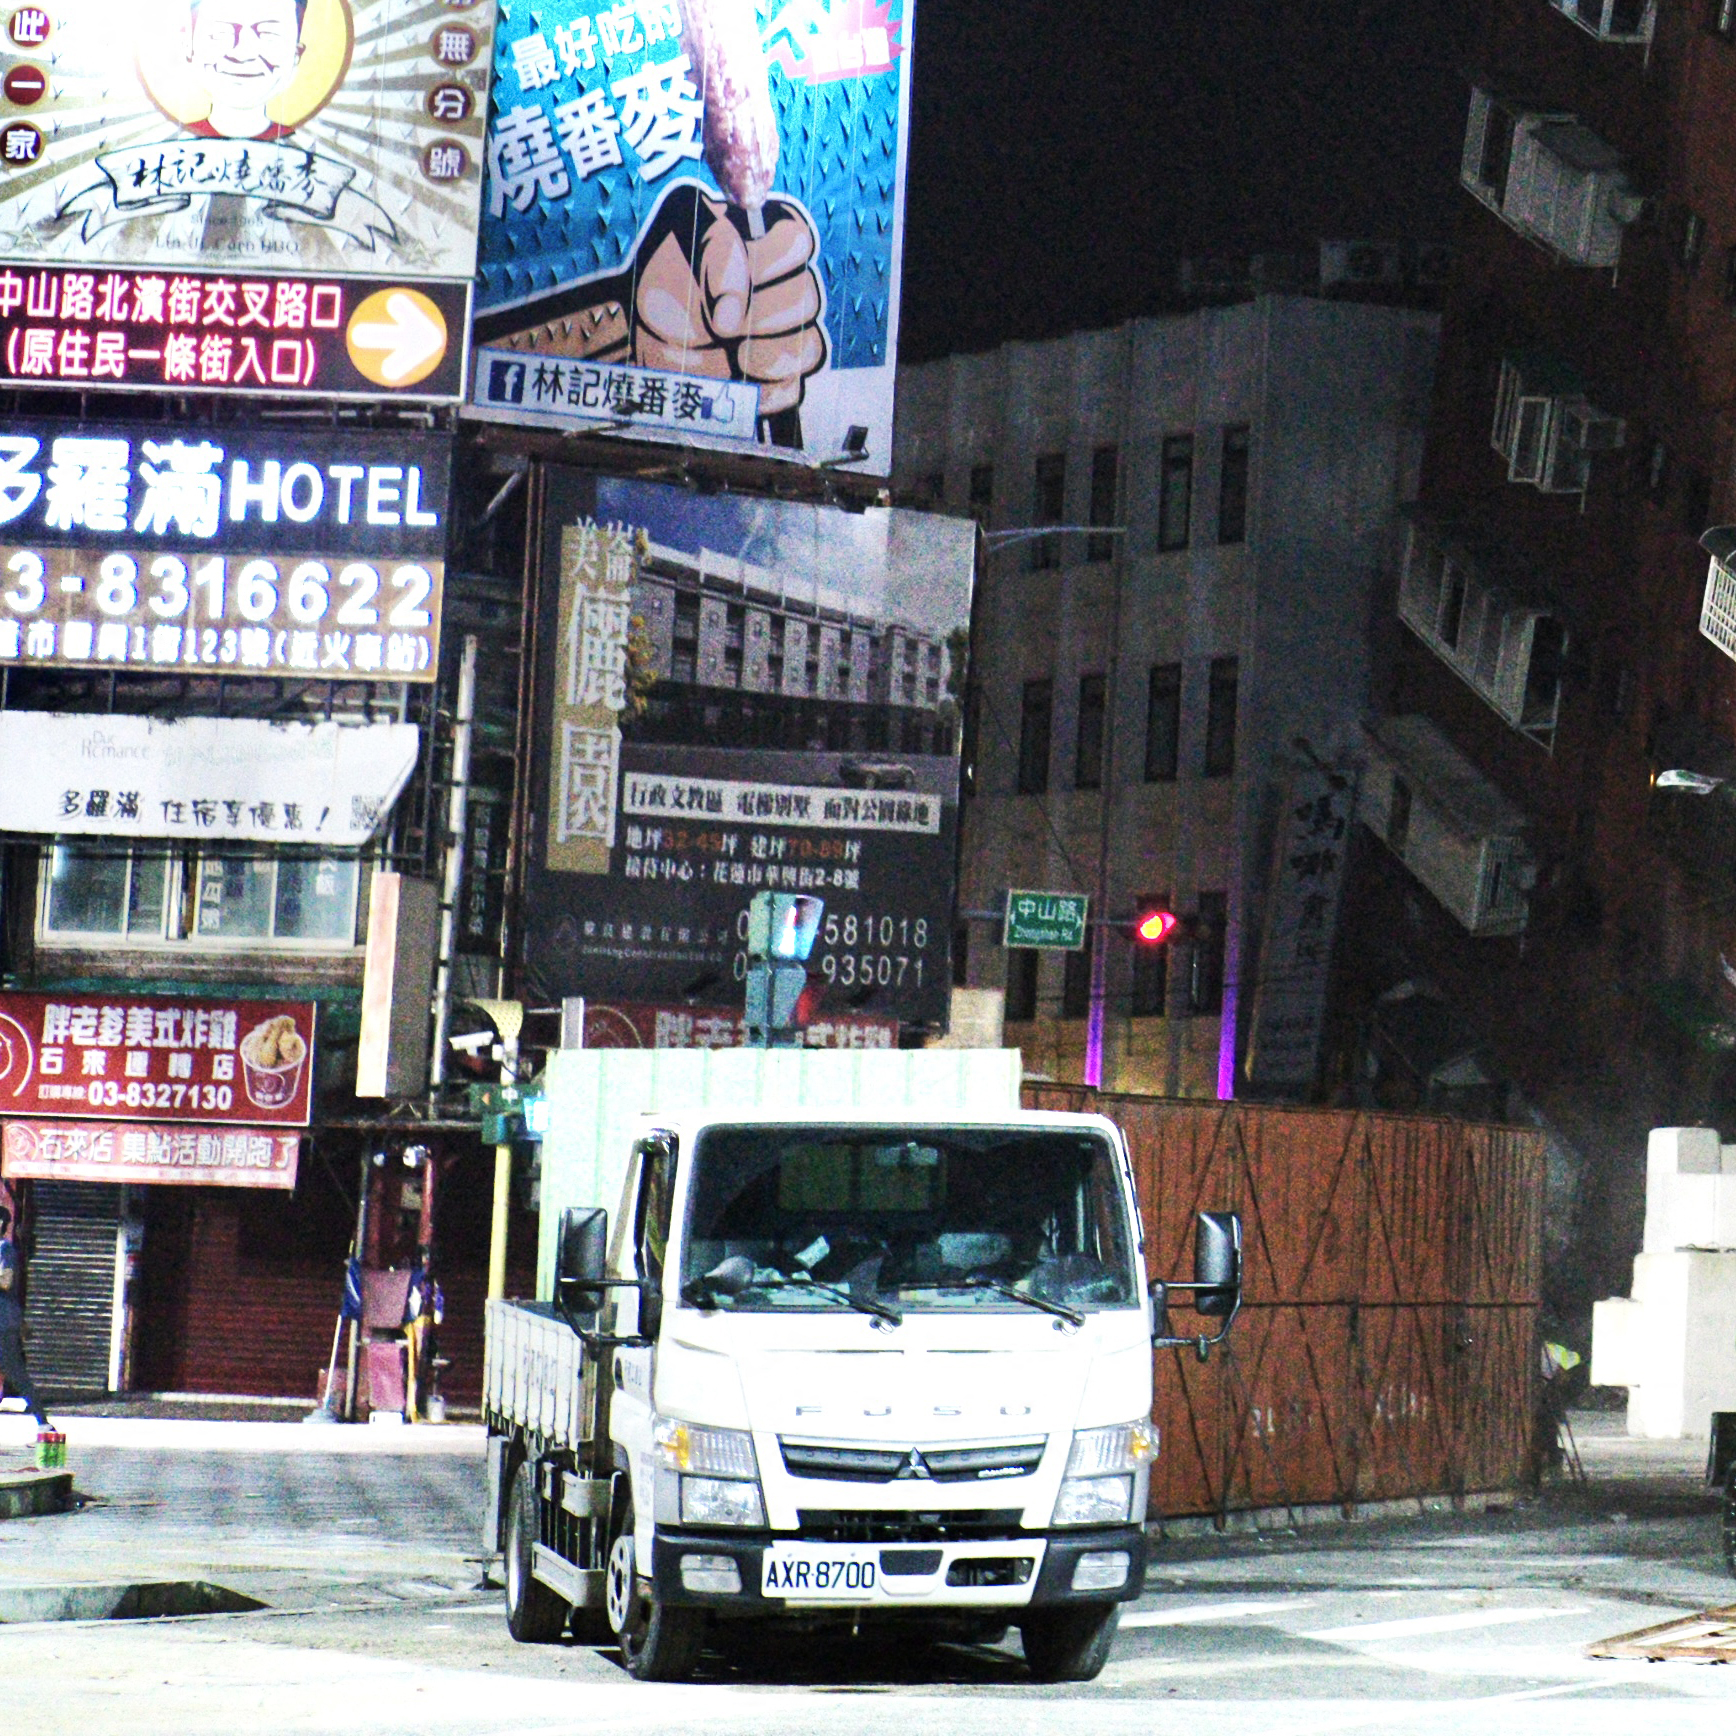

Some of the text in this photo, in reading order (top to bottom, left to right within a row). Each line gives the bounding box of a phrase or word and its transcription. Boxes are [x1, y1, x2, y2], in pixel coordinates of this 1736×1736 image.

[486, 54, 704, 217] 燒番麥
[0, 270, 341, 328] 中山路北濱街交叉路口
[7, 327, 316, 386] (原住民一條街入口)
[531, 362, 703, 421] 林記燒番麥
[229, 459, 438, 527] HOTEL
[4, 550, 433, 628] 3-8316622
[58, 789, 142, 821] 多羅滿
[1017, 898, 1078, 922] 中山路
[88, 1081, 232, 1111] 03-8327130
[39, 1127, 114, 1163] 石來店
